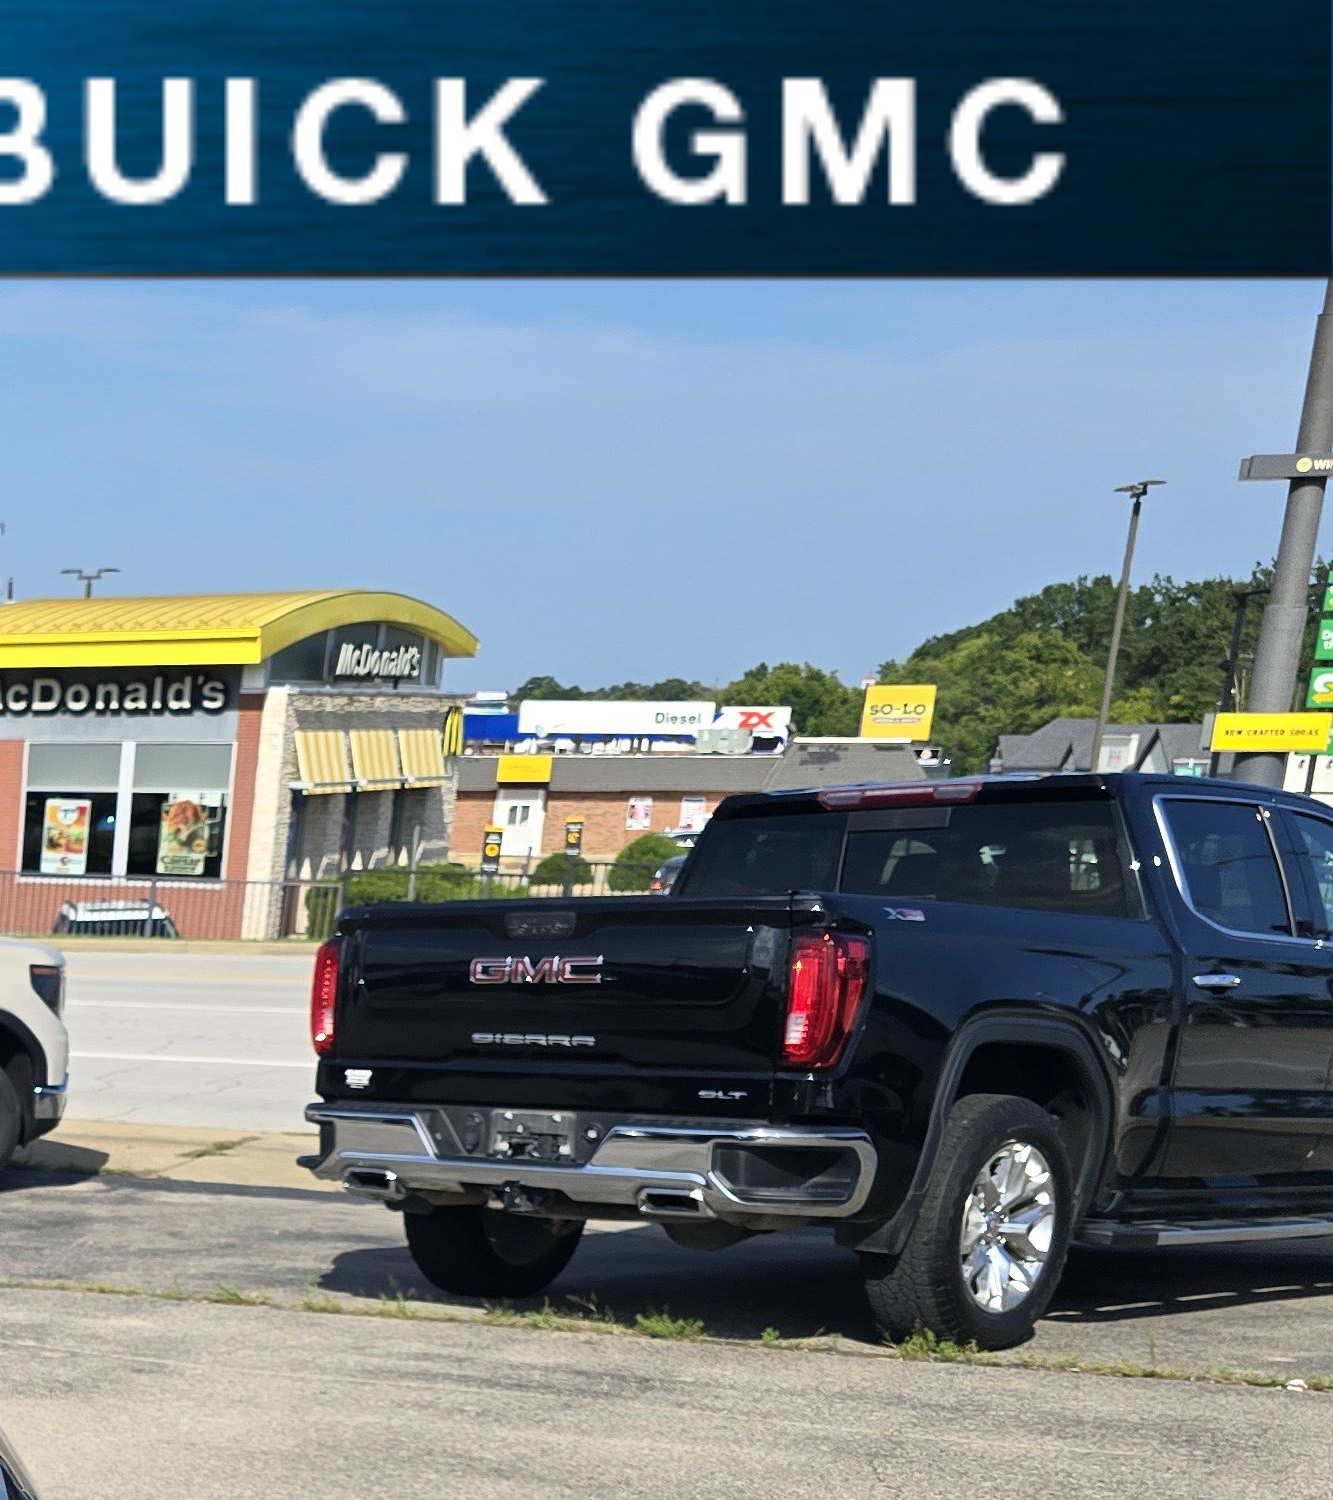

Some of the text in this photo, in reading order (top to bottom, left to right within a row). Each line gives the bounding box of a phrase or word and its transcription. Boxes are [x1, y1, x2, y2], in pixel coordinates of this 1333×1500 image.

[1314, 459, 1333, 470] WI
[335, 643, 420, 677] McDonald's
[869, 703, 926, 715] SO-LO
[655, 712, 702, 724] Diesel
[470, 955, 604, 984] GMC
[471, 1033, 596, 1047] SIERRA
